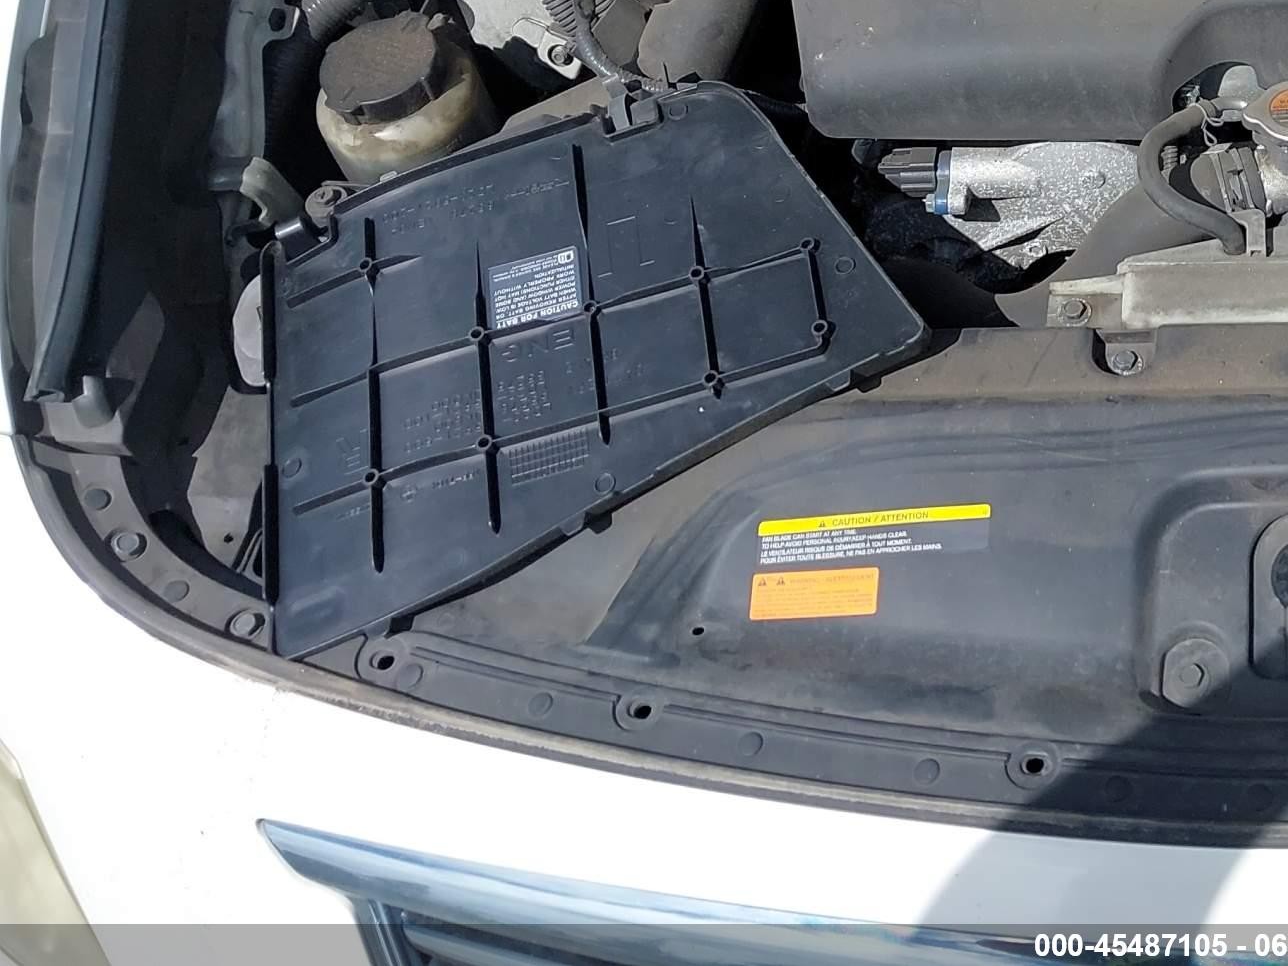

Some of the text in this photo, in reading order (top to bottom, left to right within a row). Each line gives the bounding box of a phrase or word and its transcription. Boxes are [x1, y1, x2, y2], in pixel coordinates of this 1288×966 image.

[556, 268, 574, 278] WORK
[522, 274, 553, 288] PROPERLY
[554, 280, 575, 291] POWER
[493, 283, 521, 296] WITHOUT
[507, 290, 519, 298] MAY
[527, 287, 552, 298] WINDOW
[558, 286, 576, 296] WHEN
[494, 294, 506, 302] NOT
[517, 295, 542, 307] VOLTAGE
[544, 291, 557, 300] BATT
[558, 292, 576, 302] AFTER
[495, 298, 511, 307] SOME
[524, 298, 556, 311] REMOVING
[496, 300, 577, 328] CAUTION FOR BATT
[832, 515, 870, 525] CAUTION
[880, 511, 928, 522] ATTENTION
[773, 533, 791, 541] BLADE
[802, 537, 831, 545] PERSONAL
[866, 532, 886, 540] HANDS
[760, 549, 768, 557] LE
[768, 546, 804, 556] VENTILATEUR
[871, 539, 885, 547] TOUT
[760, 555, 776, 564] POUR
[796, 552, 814, 560] TOUTE
[876, 544, 910, 554] APPROCHER
